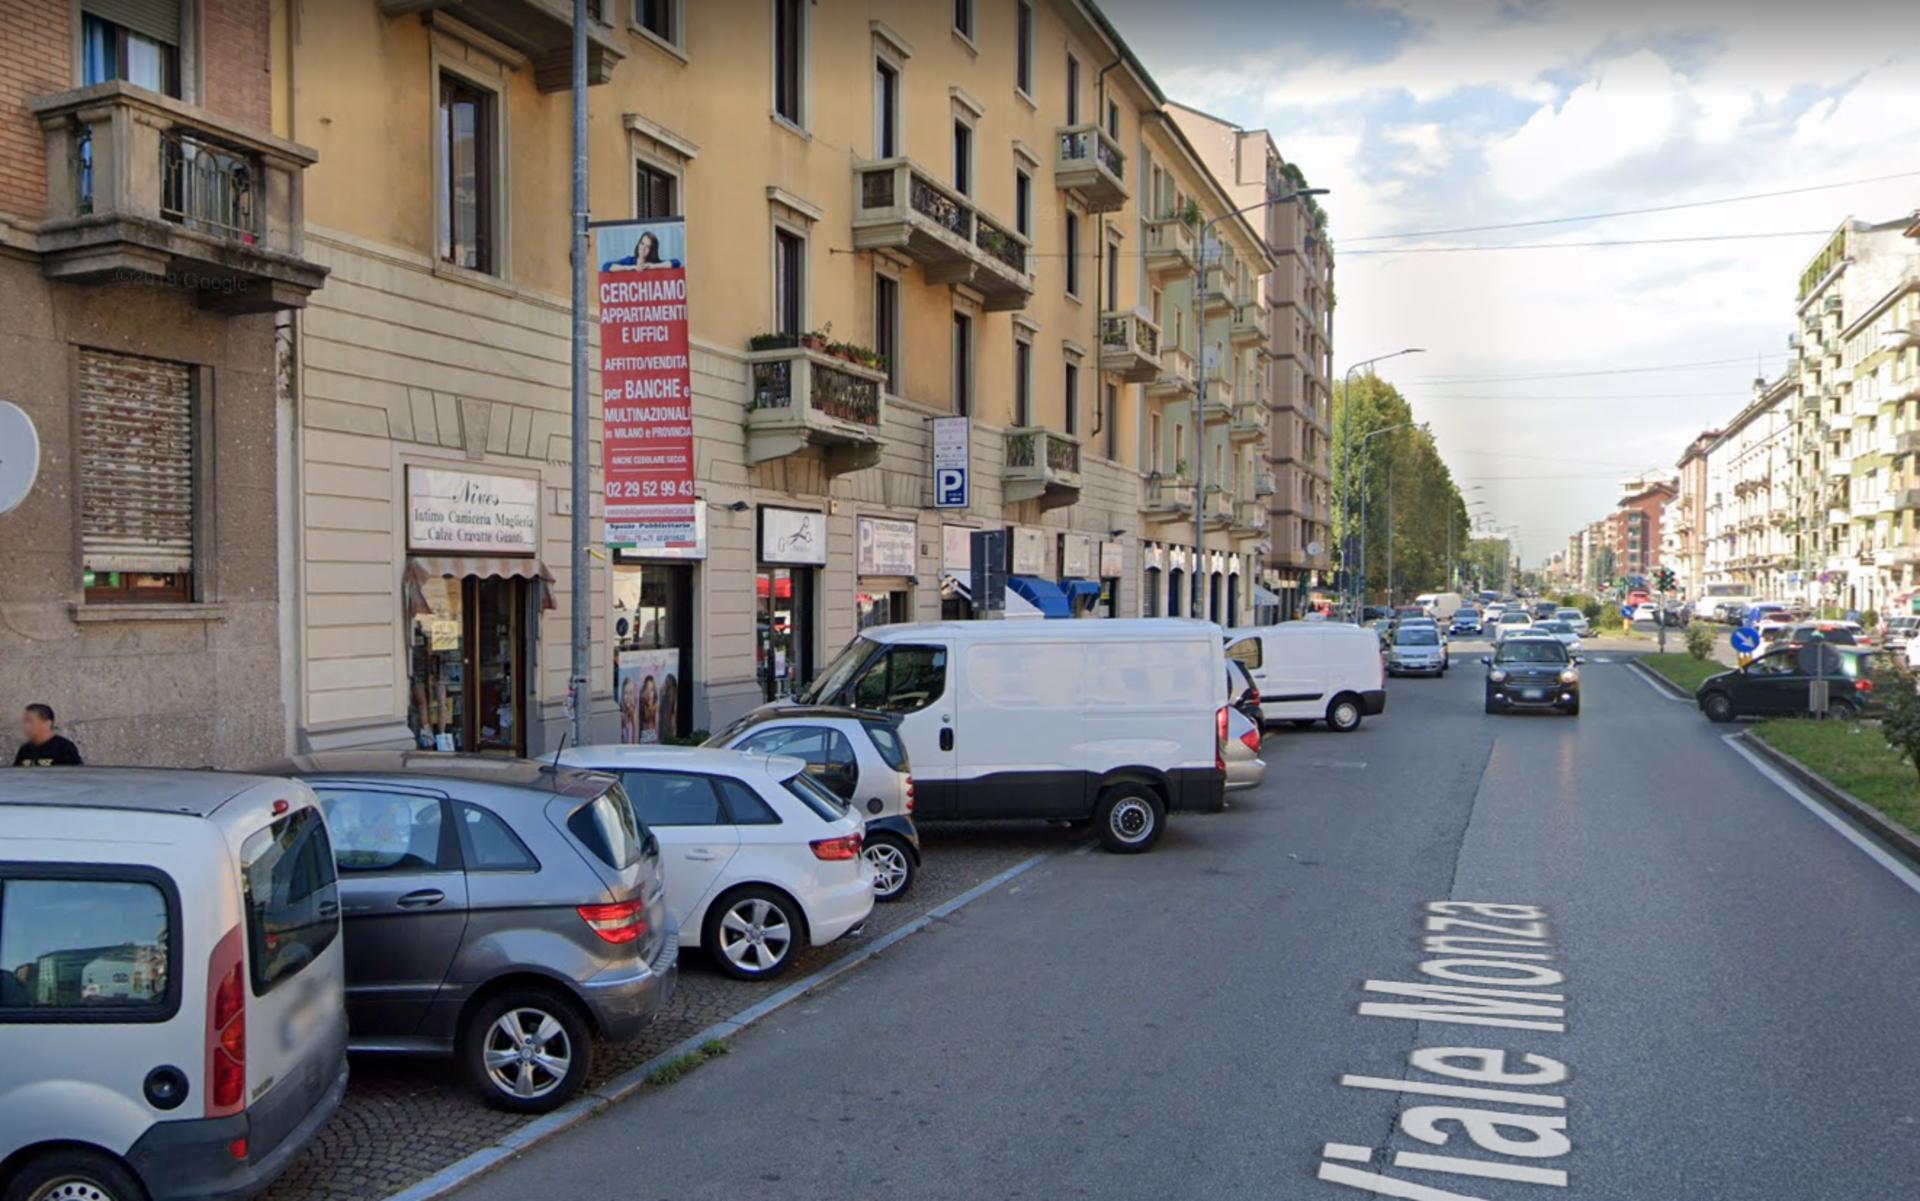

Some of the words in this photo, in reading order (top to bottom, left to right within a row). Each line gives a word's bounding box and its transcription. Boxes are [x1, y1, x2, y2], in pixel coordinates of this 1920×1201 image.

[601, 279, 685, 304] CERCHIAMO
[601, 305, 687, 323] APPARTAMENTI
[622, 327, 630, 343] E
[632, 326, 668, 343] UFFICI
[604, 355, 688, 371] AFFITTO/VENDITA
[604, 388, 622, 403] per
[625, 378, 680, 398] BANCHE
[683, 388, 690, 398] e
[604, 406, 690, 423] MULTINAZIONALI
[605, 429, 612, 439] in
[614, 428, 644, 439] MILANO
[645, 430, 651, 439] e
[652, 426, 692, 438] PROVINCIA
[453, 480, 499, 506] Nives
[606, 482, 622, 498] 02
[624, 481, 640, 497] 29
[643, 481, 658, 497] 52
[661, 480, 676, 496] 99
[678, 480, 694, 496] 43
[939, 470, 963, 503] P
[415, 508, 444, 523] Intimo
[448, 510, 491, 526] Camiceria
[495, 513, 534, 529] Maglieria
[427, 527, 453, 541] Calze
[457, 528, 492, 542] Cravatte
[496, 531, 523, 543] Guanti
